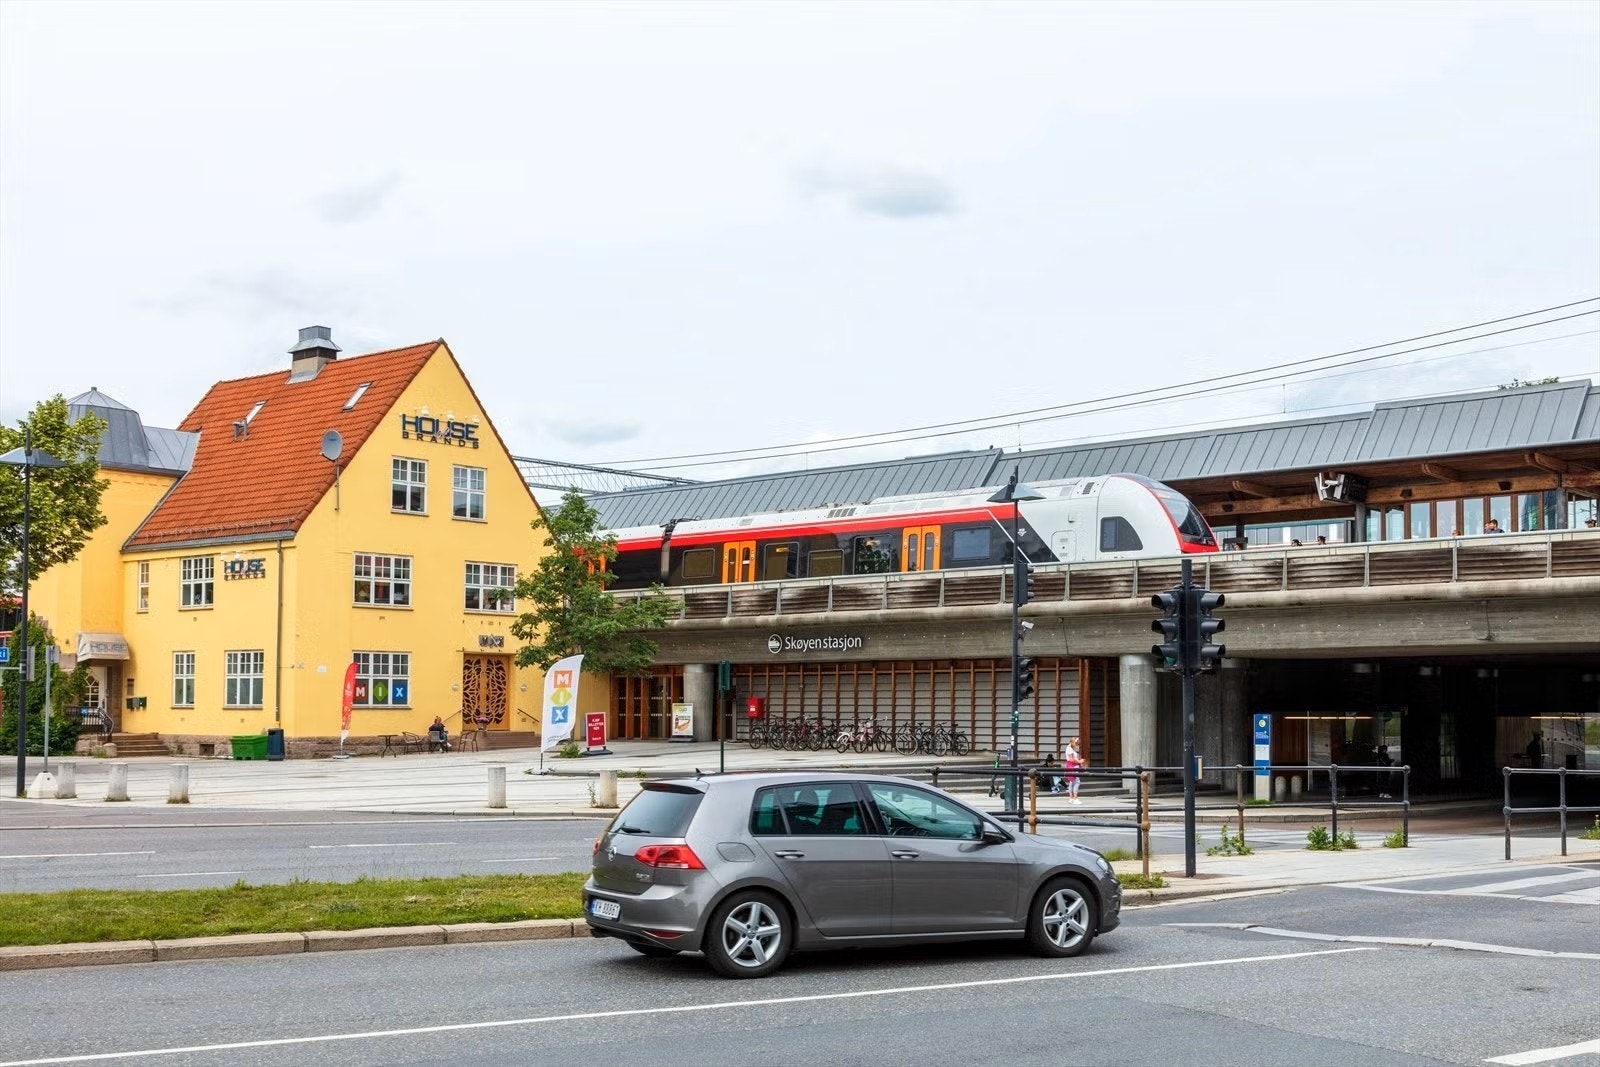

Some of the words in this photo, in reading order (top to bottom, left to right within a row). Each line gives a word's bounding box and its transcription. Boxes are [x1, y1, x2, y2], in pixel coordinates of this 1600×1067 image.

[402, 413, 479, 441] HOUSE
[402, 431, 479, 449] BRANDS
[784, 636, 822, 652] Skøyen
[822, 634, 862, 651] stasjon
